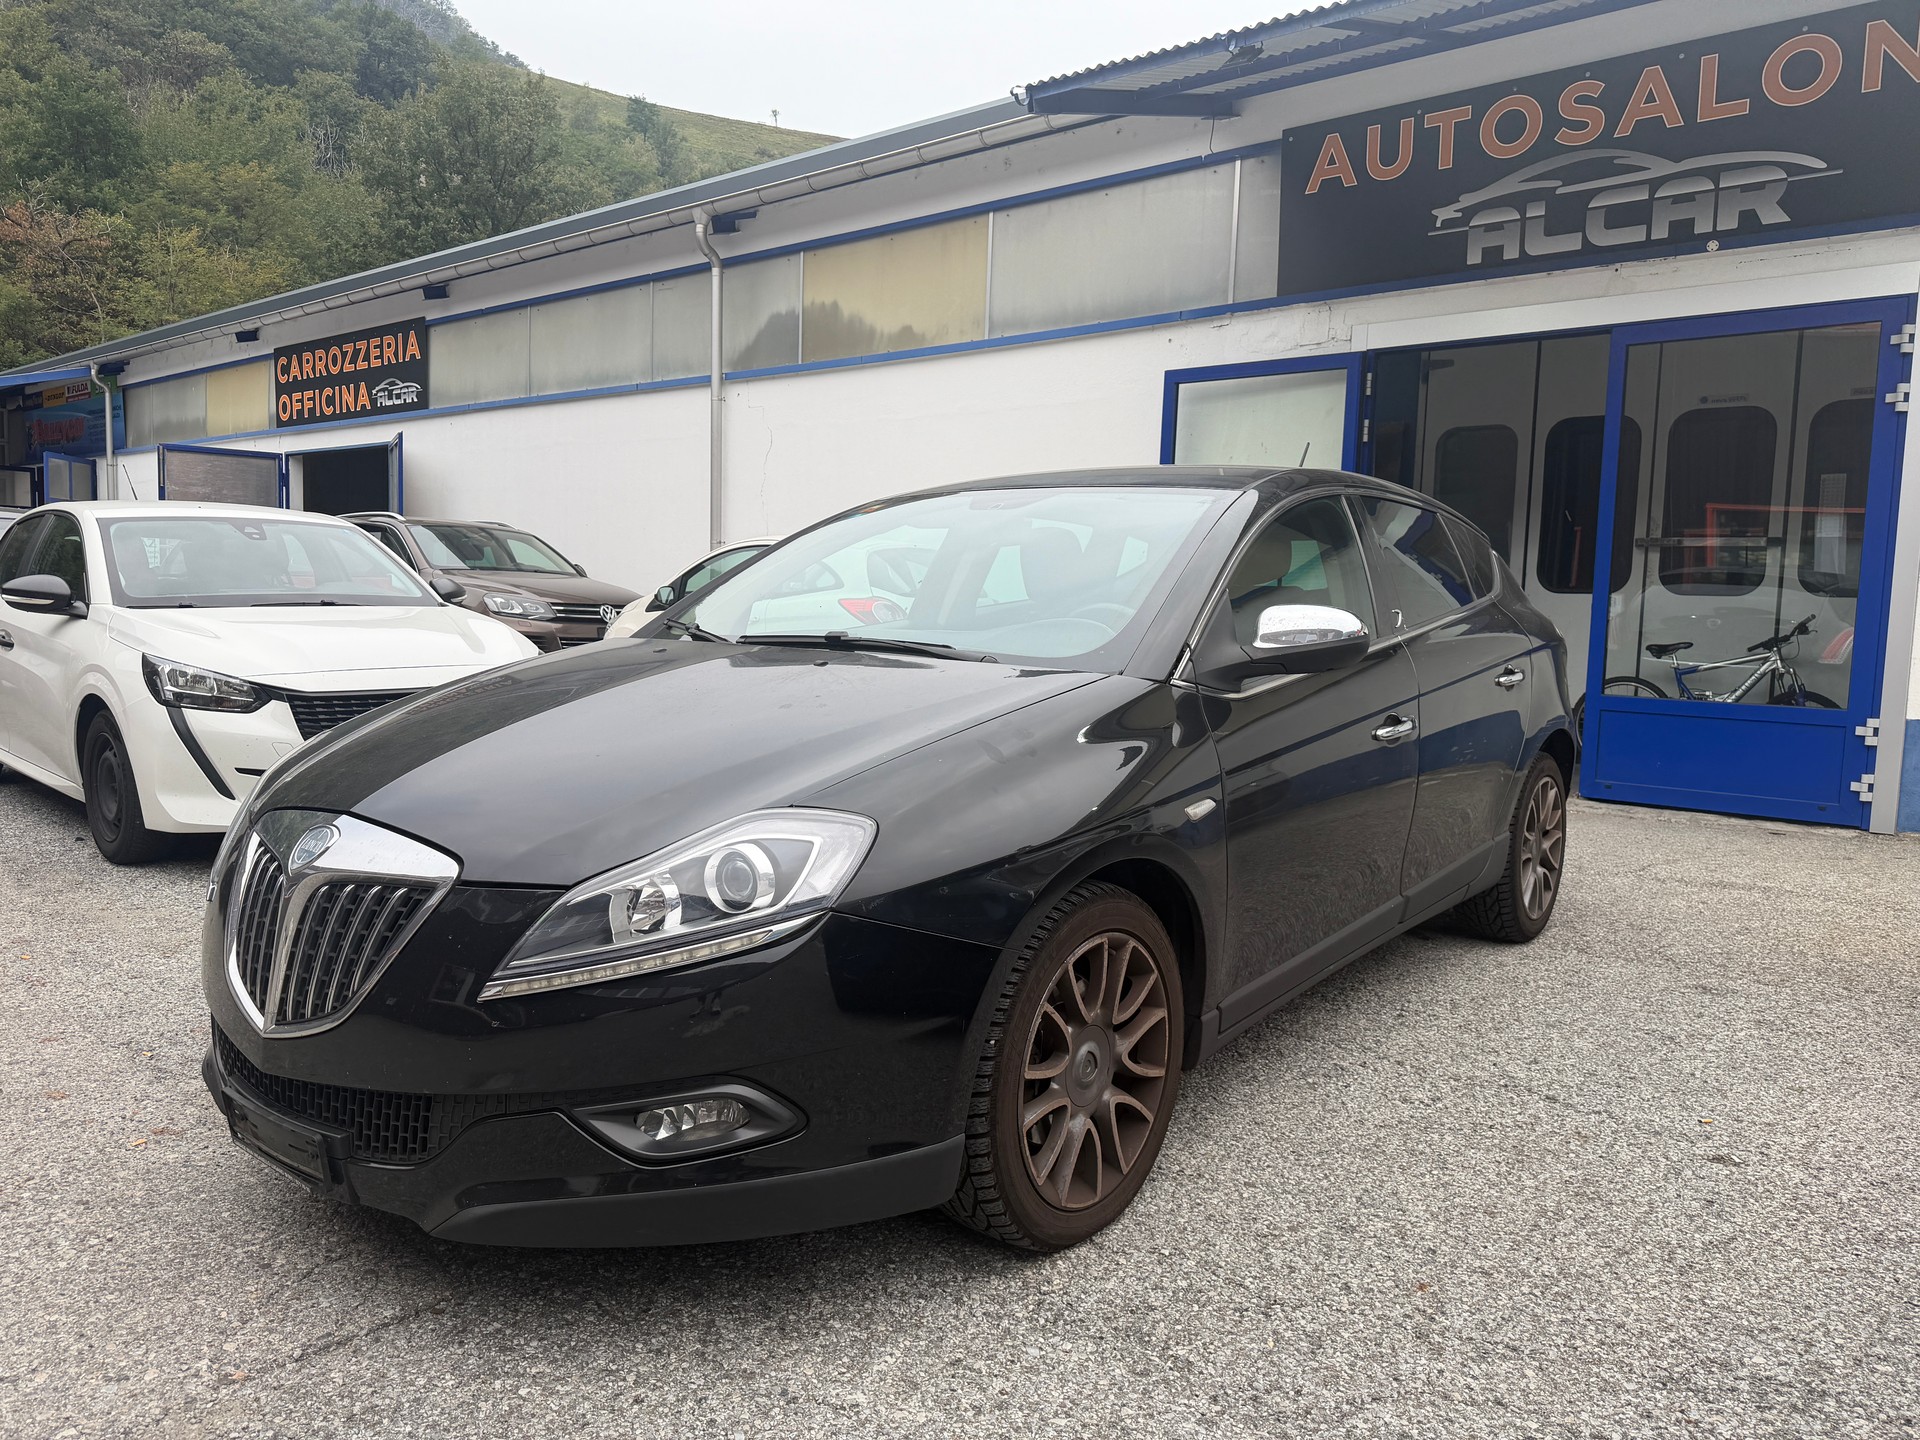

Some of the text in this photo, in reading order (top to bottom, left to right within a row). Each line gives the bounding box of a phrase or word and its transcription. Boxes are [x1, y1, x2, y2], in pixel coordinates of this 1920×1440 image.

[1305, 19, 1920, 194] AUTOSALON
[1466, 164, 1791, 265] ALCAR
[277, 330, 421, 383] CARROZZERIA
[72, 383, 89, 394] FULDA
[278, 381, 418, 421] OFFICINA ALCAR
